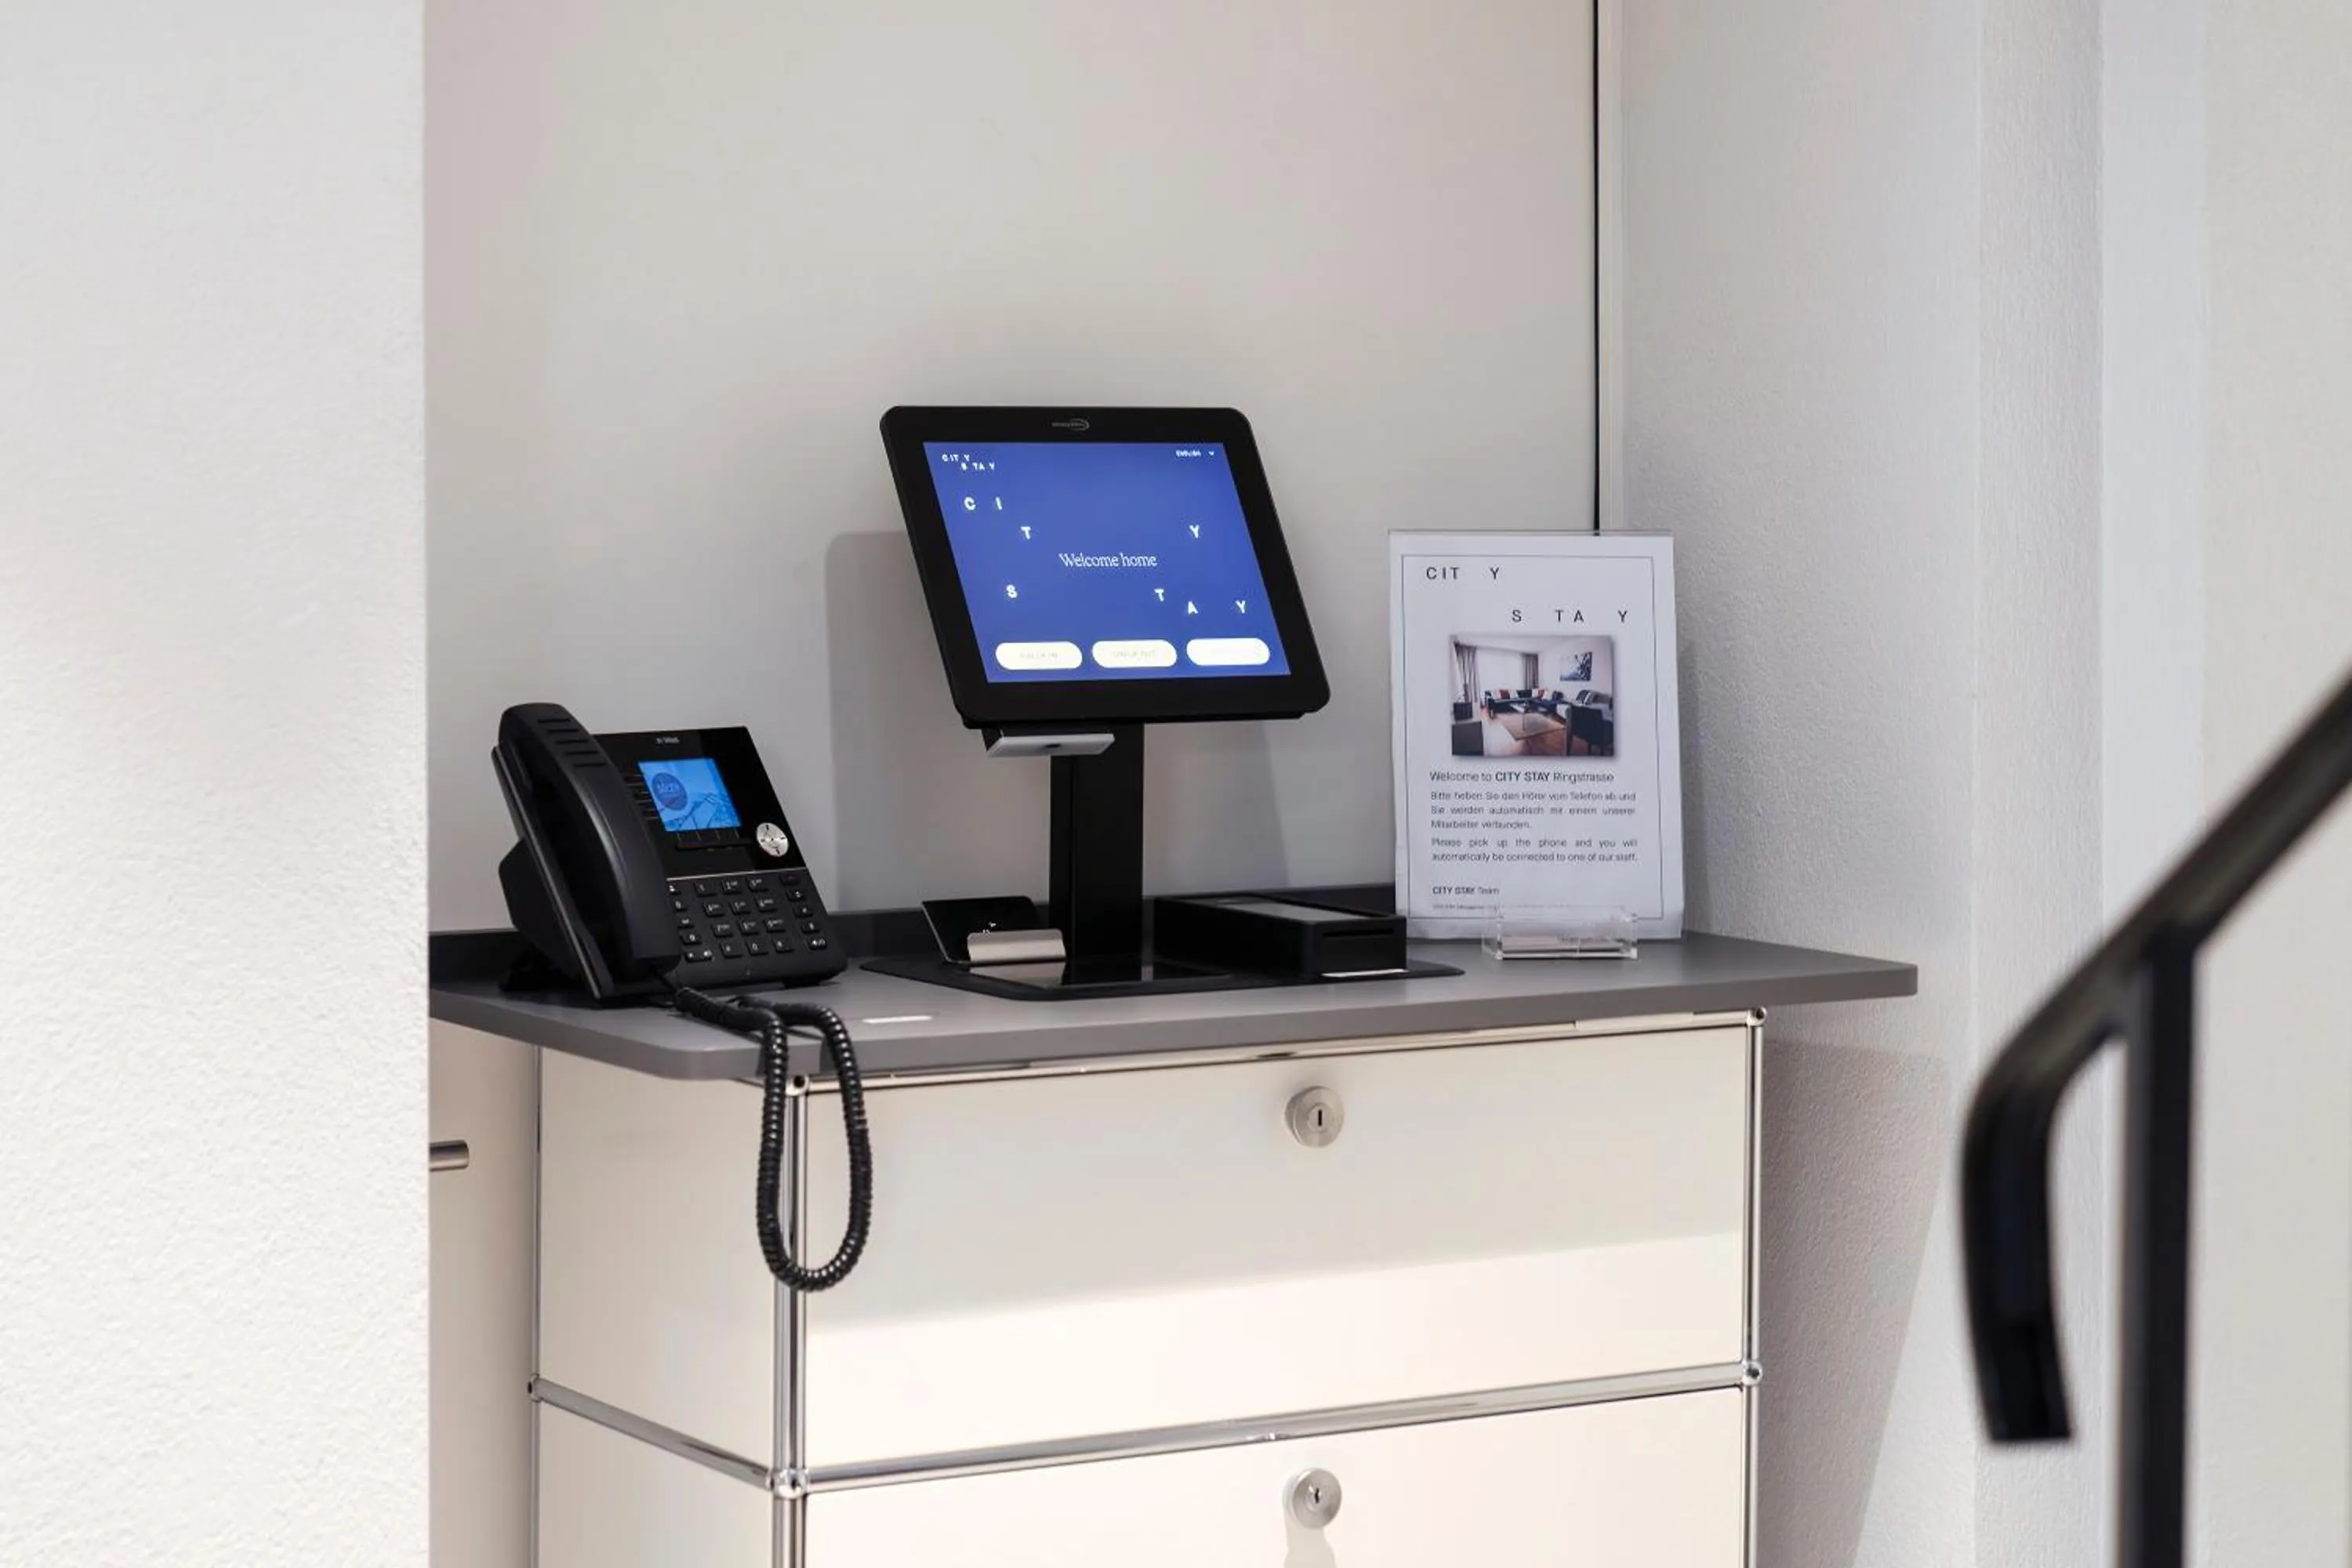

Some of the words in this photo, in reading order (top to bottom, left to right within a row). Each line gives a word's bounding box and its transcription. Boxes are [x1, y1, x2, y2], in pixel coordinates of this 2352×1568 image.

[1058, 552, 1119, 567] Welcome
[1120, 552, 1157, 567] home
[1429, 771, 1479, 782] Welcome
[1481, 771, 1492, 782] to
[1495, 771, 1521, 782] CITY
[1524, 771, 1550, 782] STAY
[1553, 771, 1615, 785] Ringstrasse
